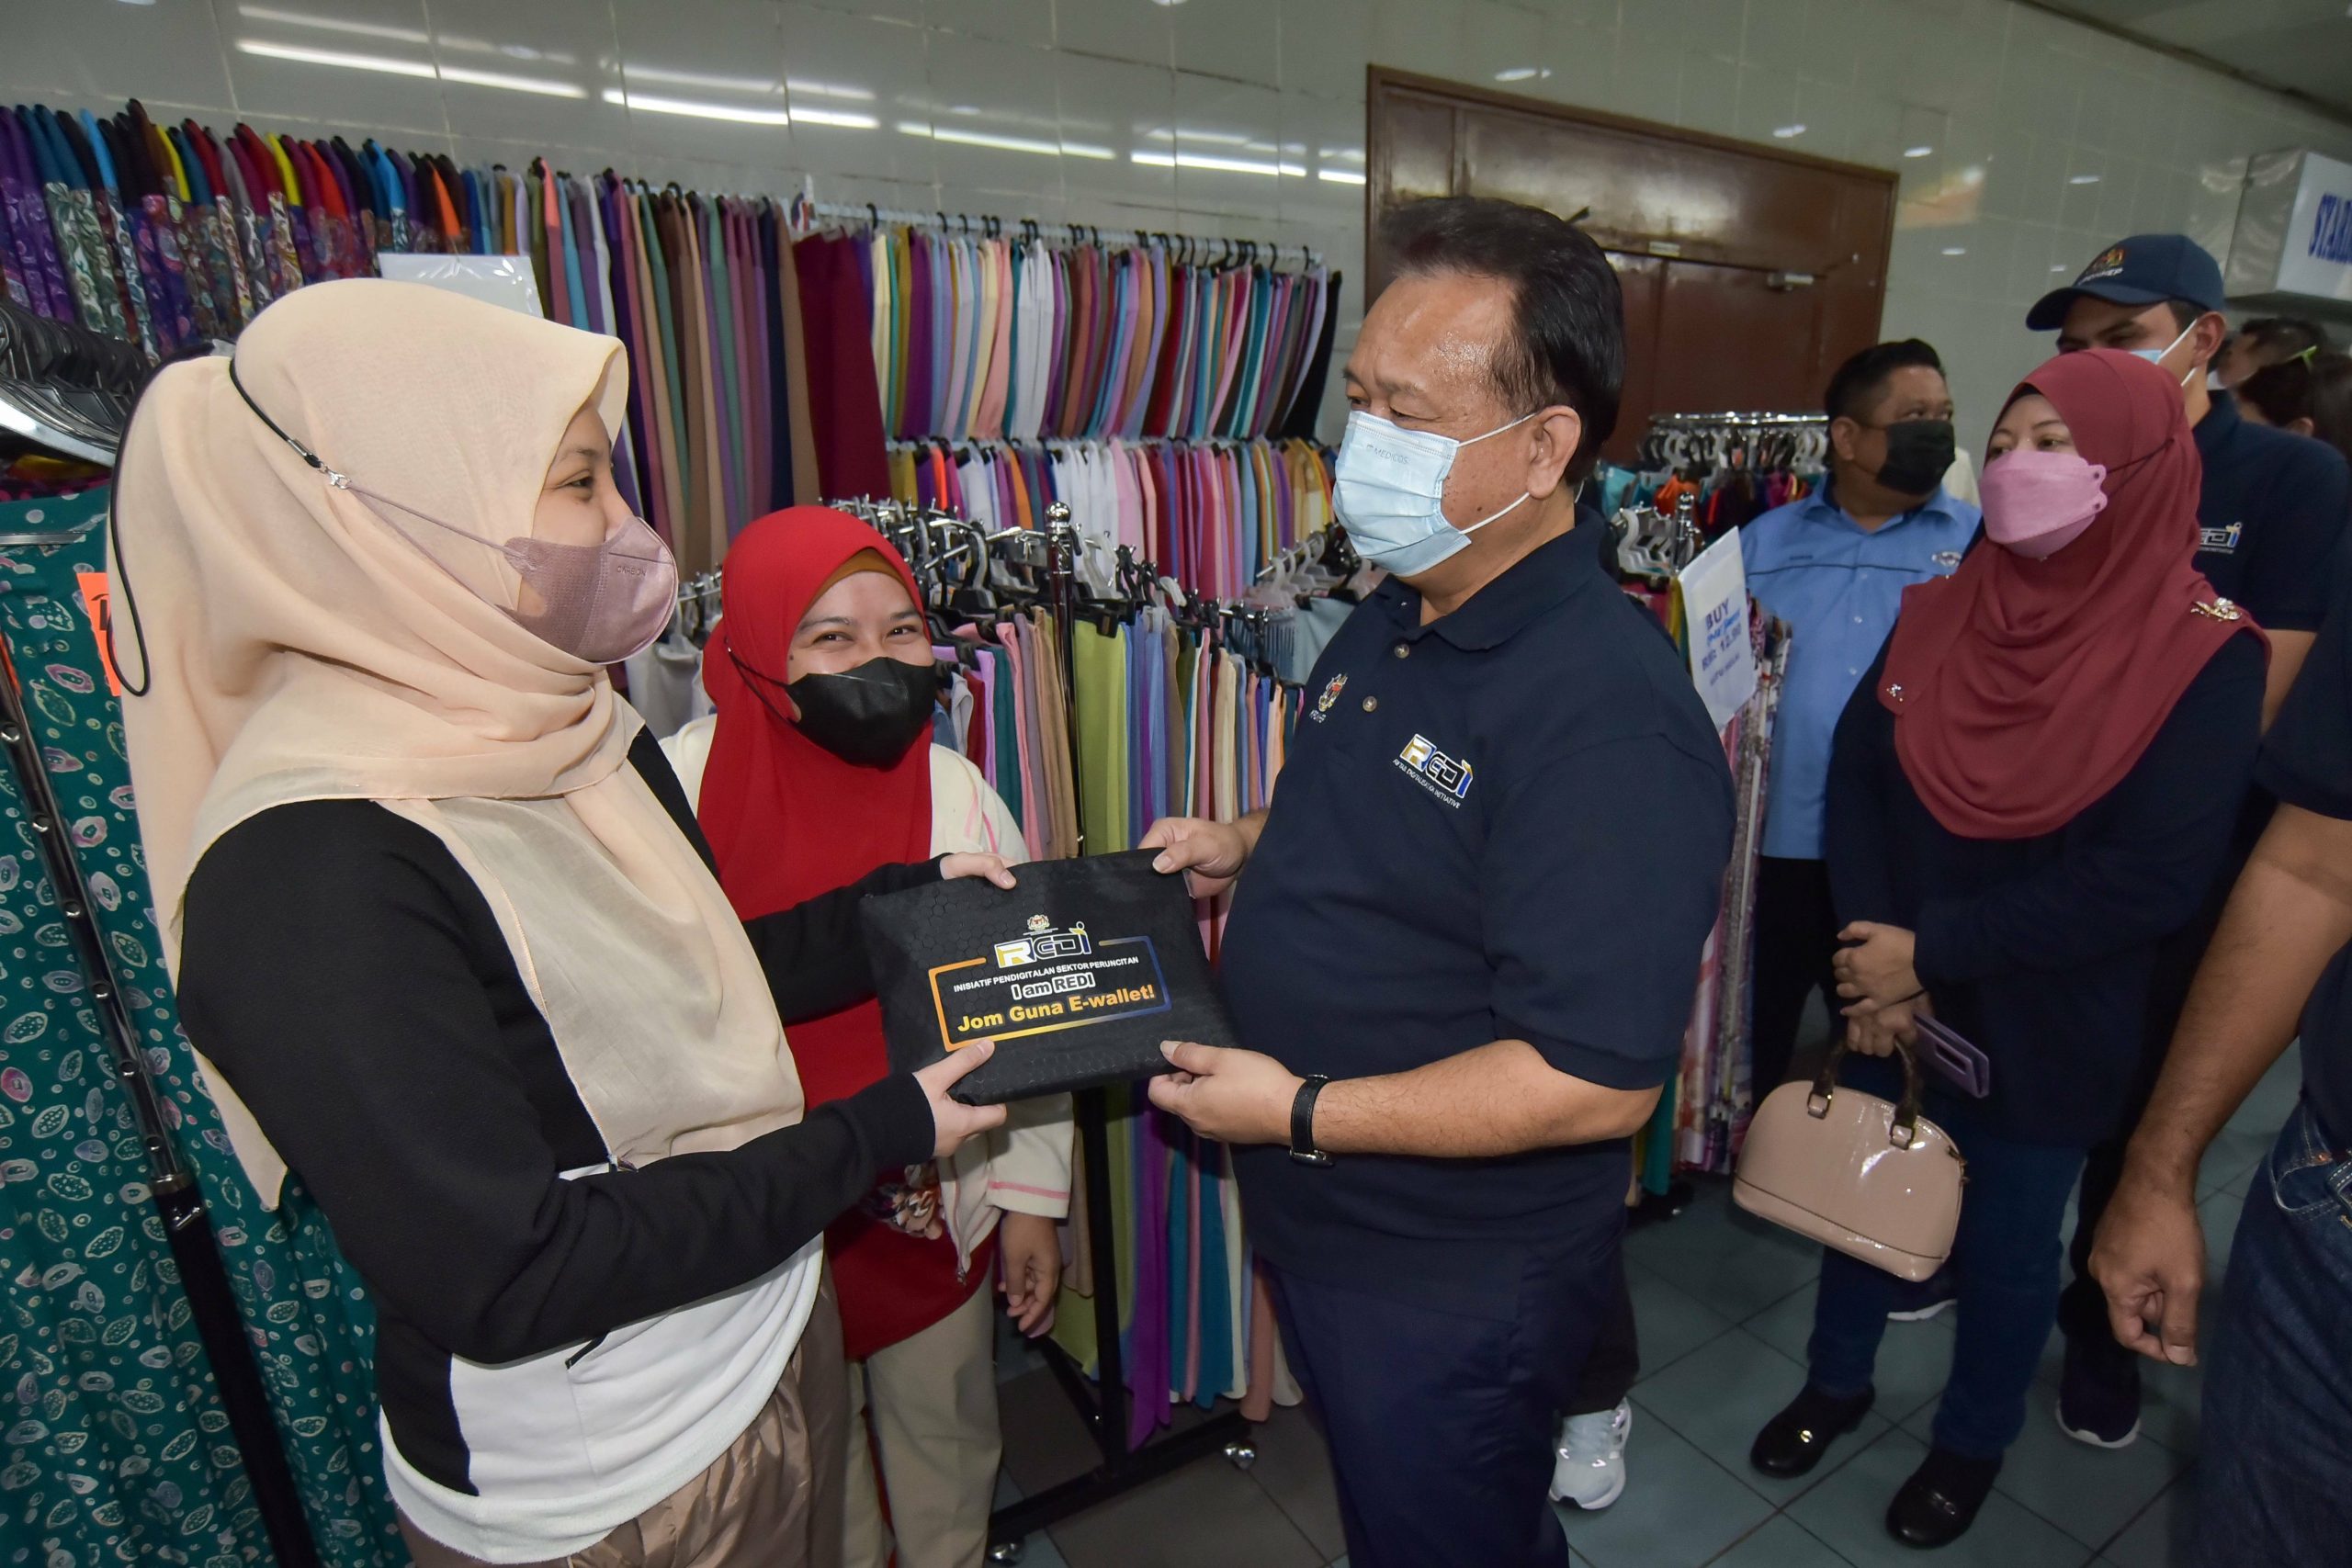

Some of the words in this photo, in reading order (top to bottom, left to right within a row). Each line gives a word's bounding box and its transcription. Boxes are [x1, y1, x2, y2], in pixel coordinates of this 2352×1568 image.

[1705, 598, 1729, 630] BUY
[954, 977, 992, 993] INISIATIF
[993, 967, 1056, 985] PENDIGITALAN
[1056, 961, 1090, 974] SEKTOR
[1090, 956, 1139, 969] PERUNCITAN
[1023, 982, 1051, 998] am
[1052, 972, 1096, 993] REDI
[957, 1012, 1003, 1032] Jom
[1009, 1001, 1064, 1022] Guna
[1068, 984, 1156, 1012] E-wallet!
